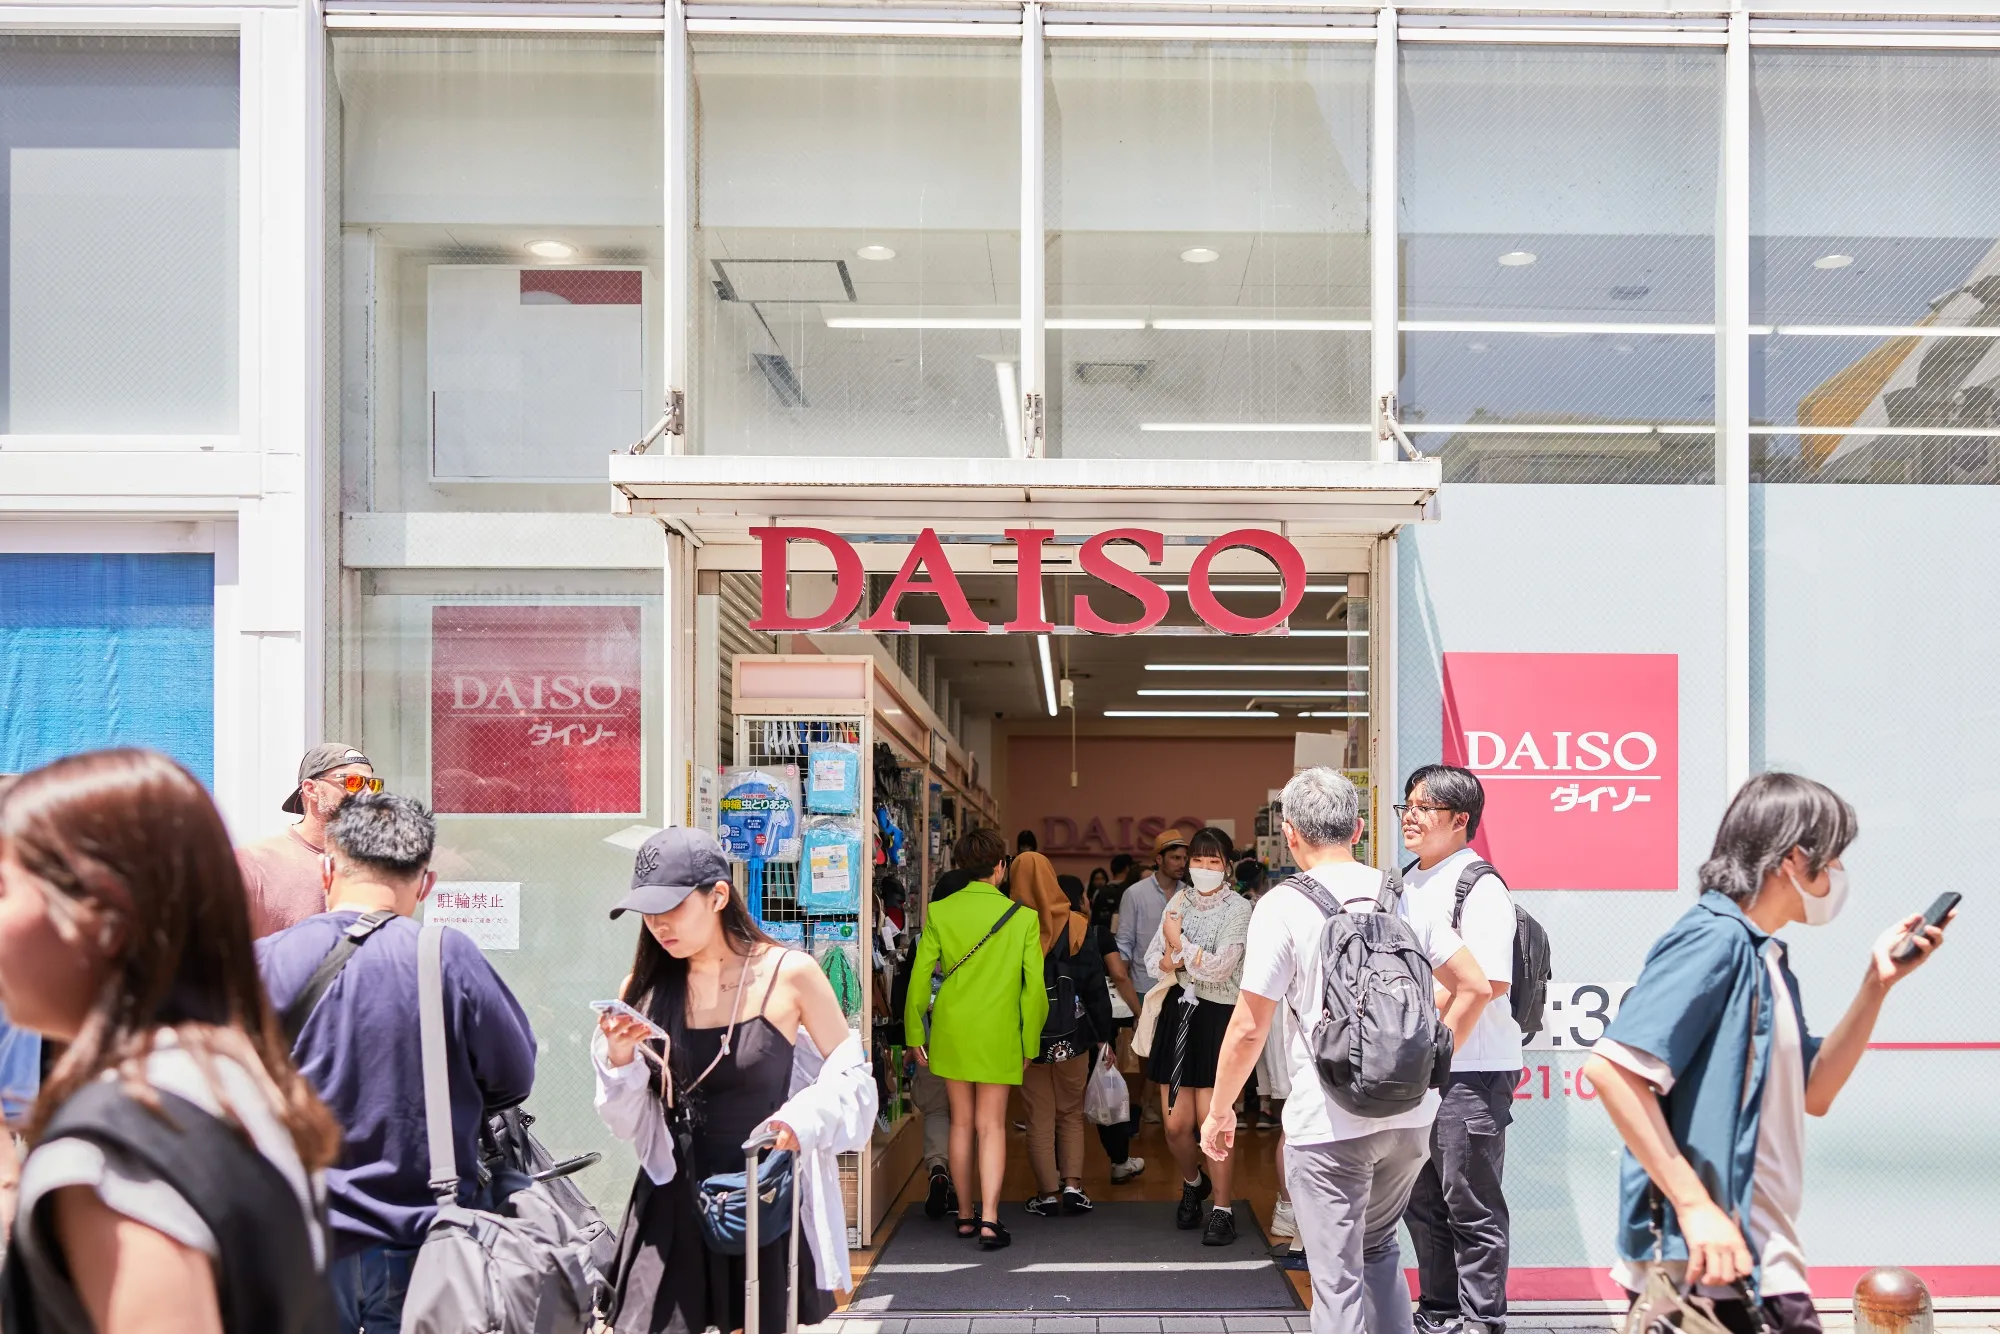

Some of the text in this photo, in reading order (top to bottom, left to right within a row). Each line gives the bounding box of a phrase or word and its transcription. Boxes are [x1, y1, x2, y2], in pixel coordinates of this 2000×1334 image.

[749, 526, 1308, 636] DAISO
[451, 674, 623, 711] DAISO
[527, 721, 617, 746] ダイソー
[1463, 731, 1658, 771] DAISO
[1550, 783, 1651, 812] ダイソー
[436, 892, 505, 909] 駐輪禁止
[1522, 984, 1636, 1048] :3
